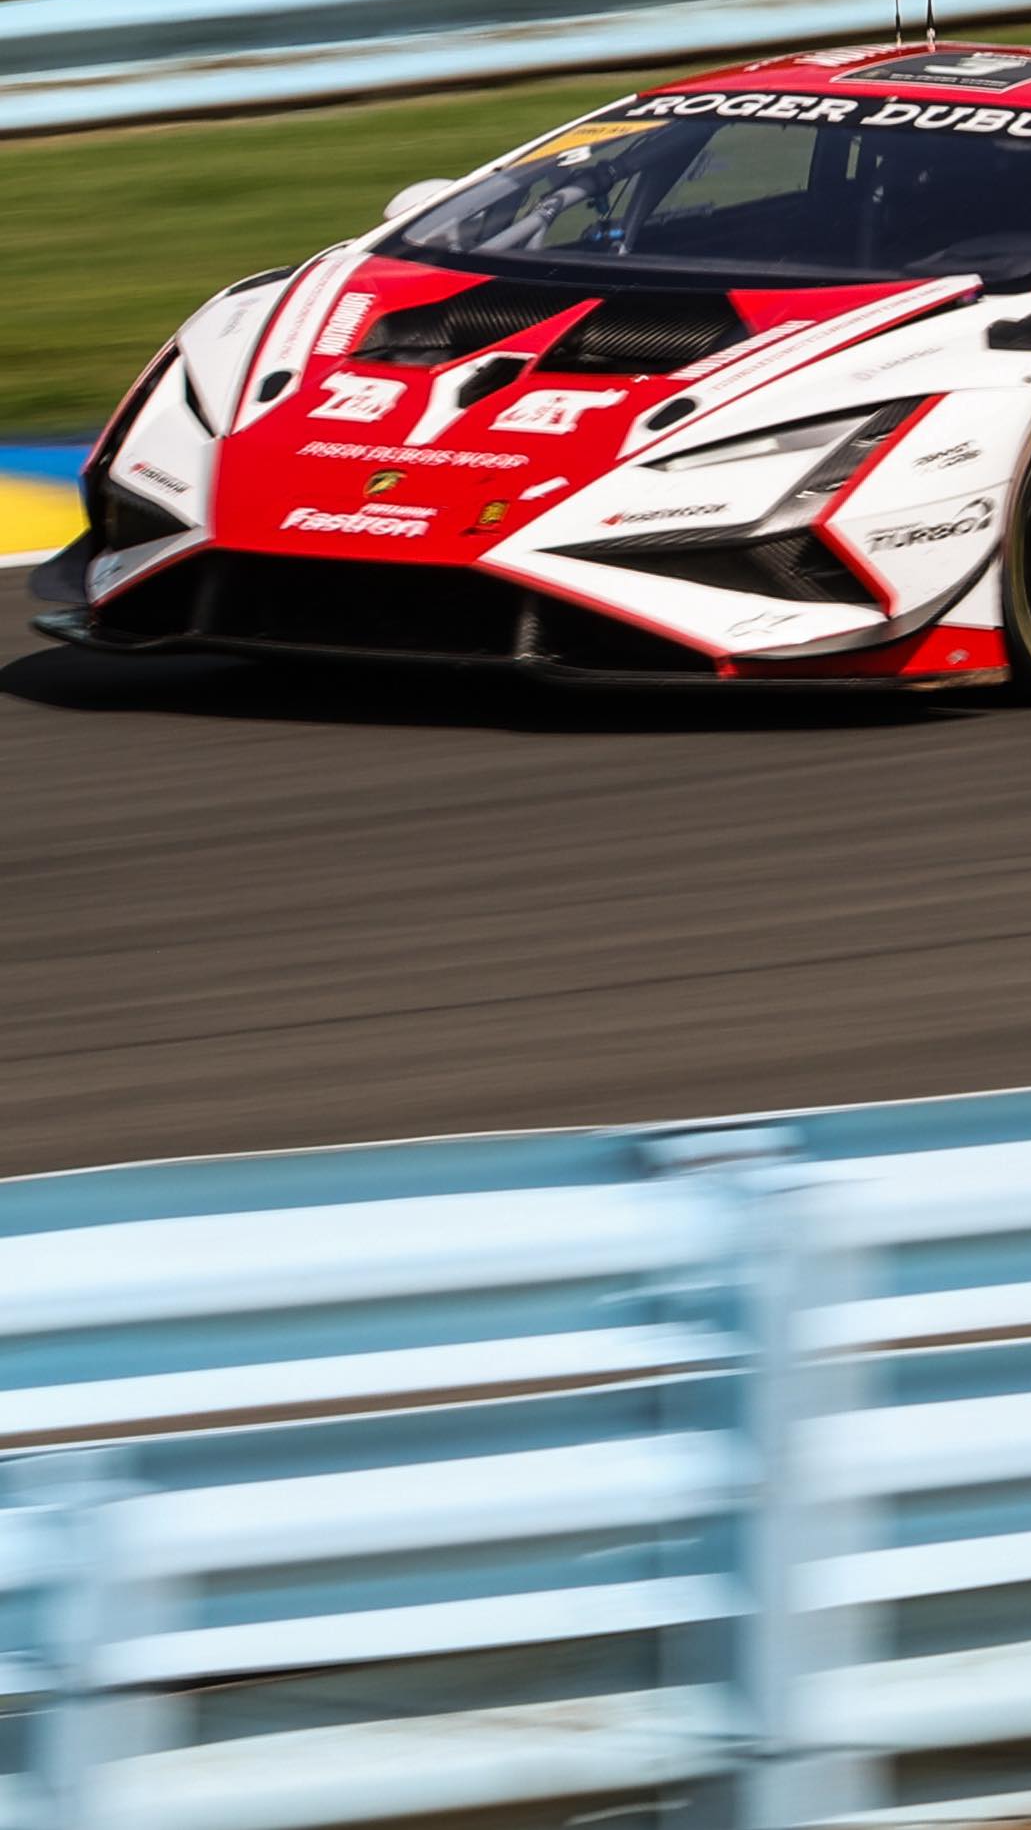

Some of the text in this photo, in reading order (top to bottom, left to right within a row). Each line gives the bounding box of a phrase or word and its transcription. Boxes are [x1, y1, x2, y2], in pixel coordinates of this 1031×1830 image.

[625, 93, 859, 122] ROGER
[556, 145, 592, 167] 3
[280, 506, 430, 538] Fastron
